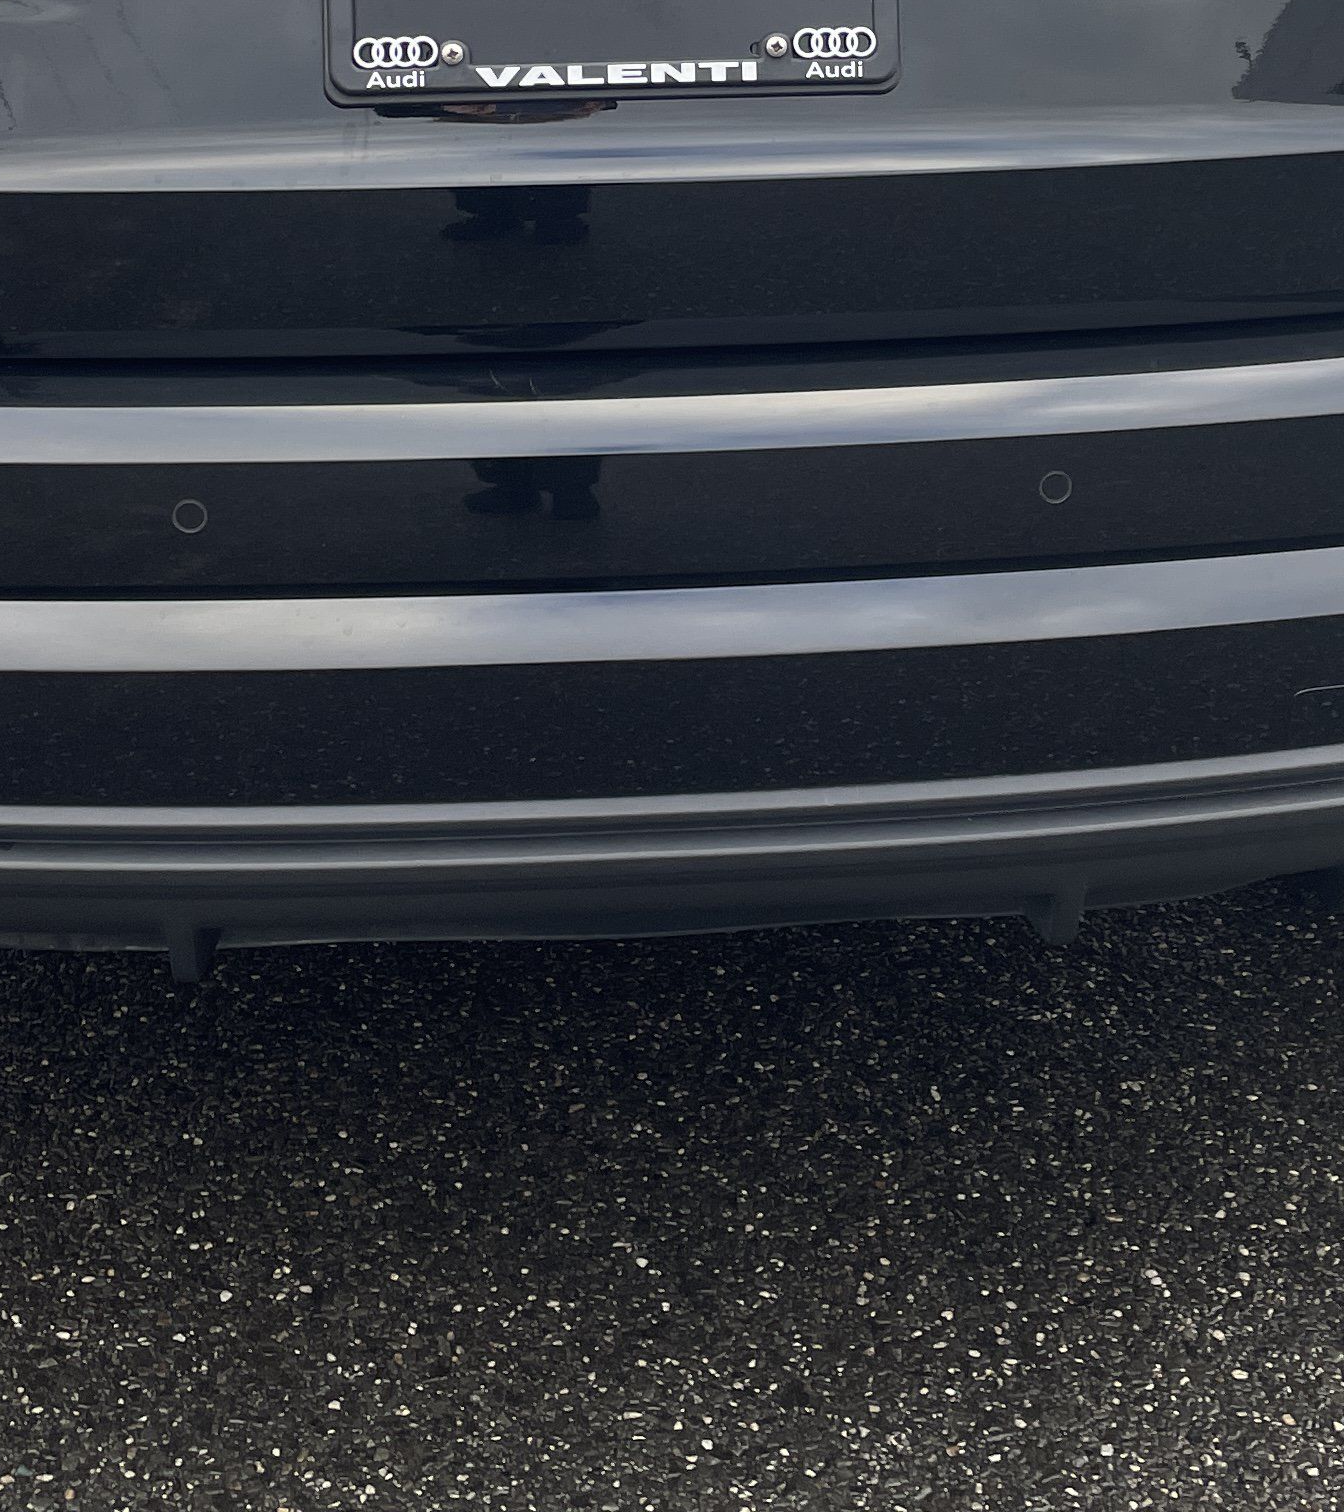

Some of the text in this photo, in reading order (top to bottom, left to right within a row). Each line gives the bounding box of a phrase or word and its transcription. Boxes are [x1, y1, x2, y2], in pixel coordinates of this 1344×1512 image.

[475, 61, 758, 88] VALENTI
[805, 60, 864, 79] Audi
[366, 70, 426, 89] Audi
